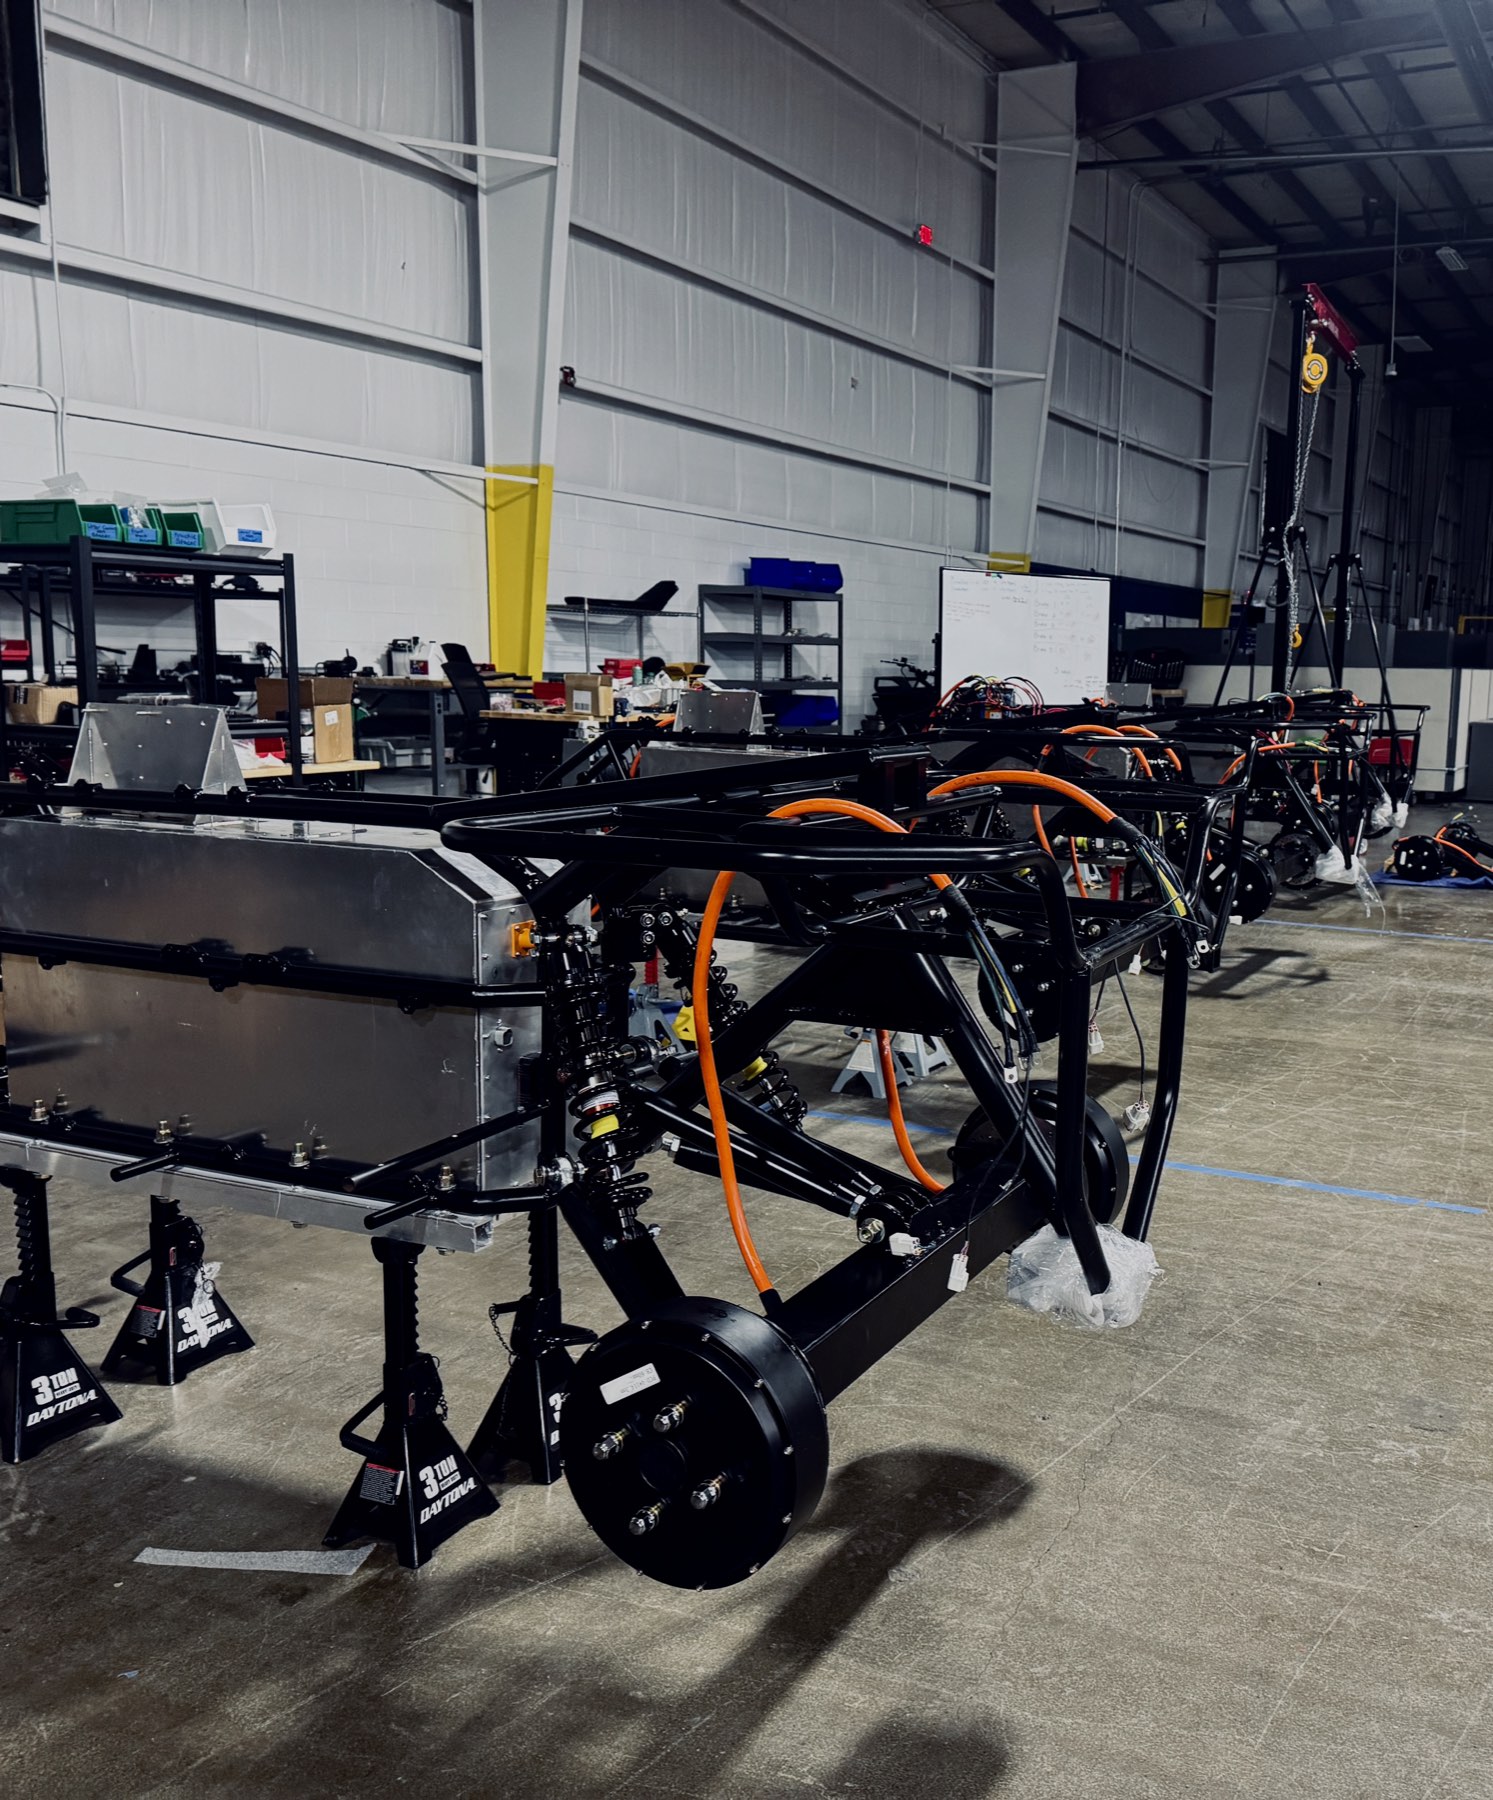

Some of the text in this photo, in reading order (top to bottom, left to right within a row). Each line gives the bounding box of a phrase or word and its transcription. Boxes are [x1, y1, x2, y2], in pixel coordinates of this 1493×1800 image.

[31, 1367, 78, 1405] 3 TON
[26, 1389, 99, 1427] DAYTONA
[419, 1465, 440, 1499] 3
[433, 1454, 458, 1480] TON
[420, 1476, 478, 1525] DAYTONA
